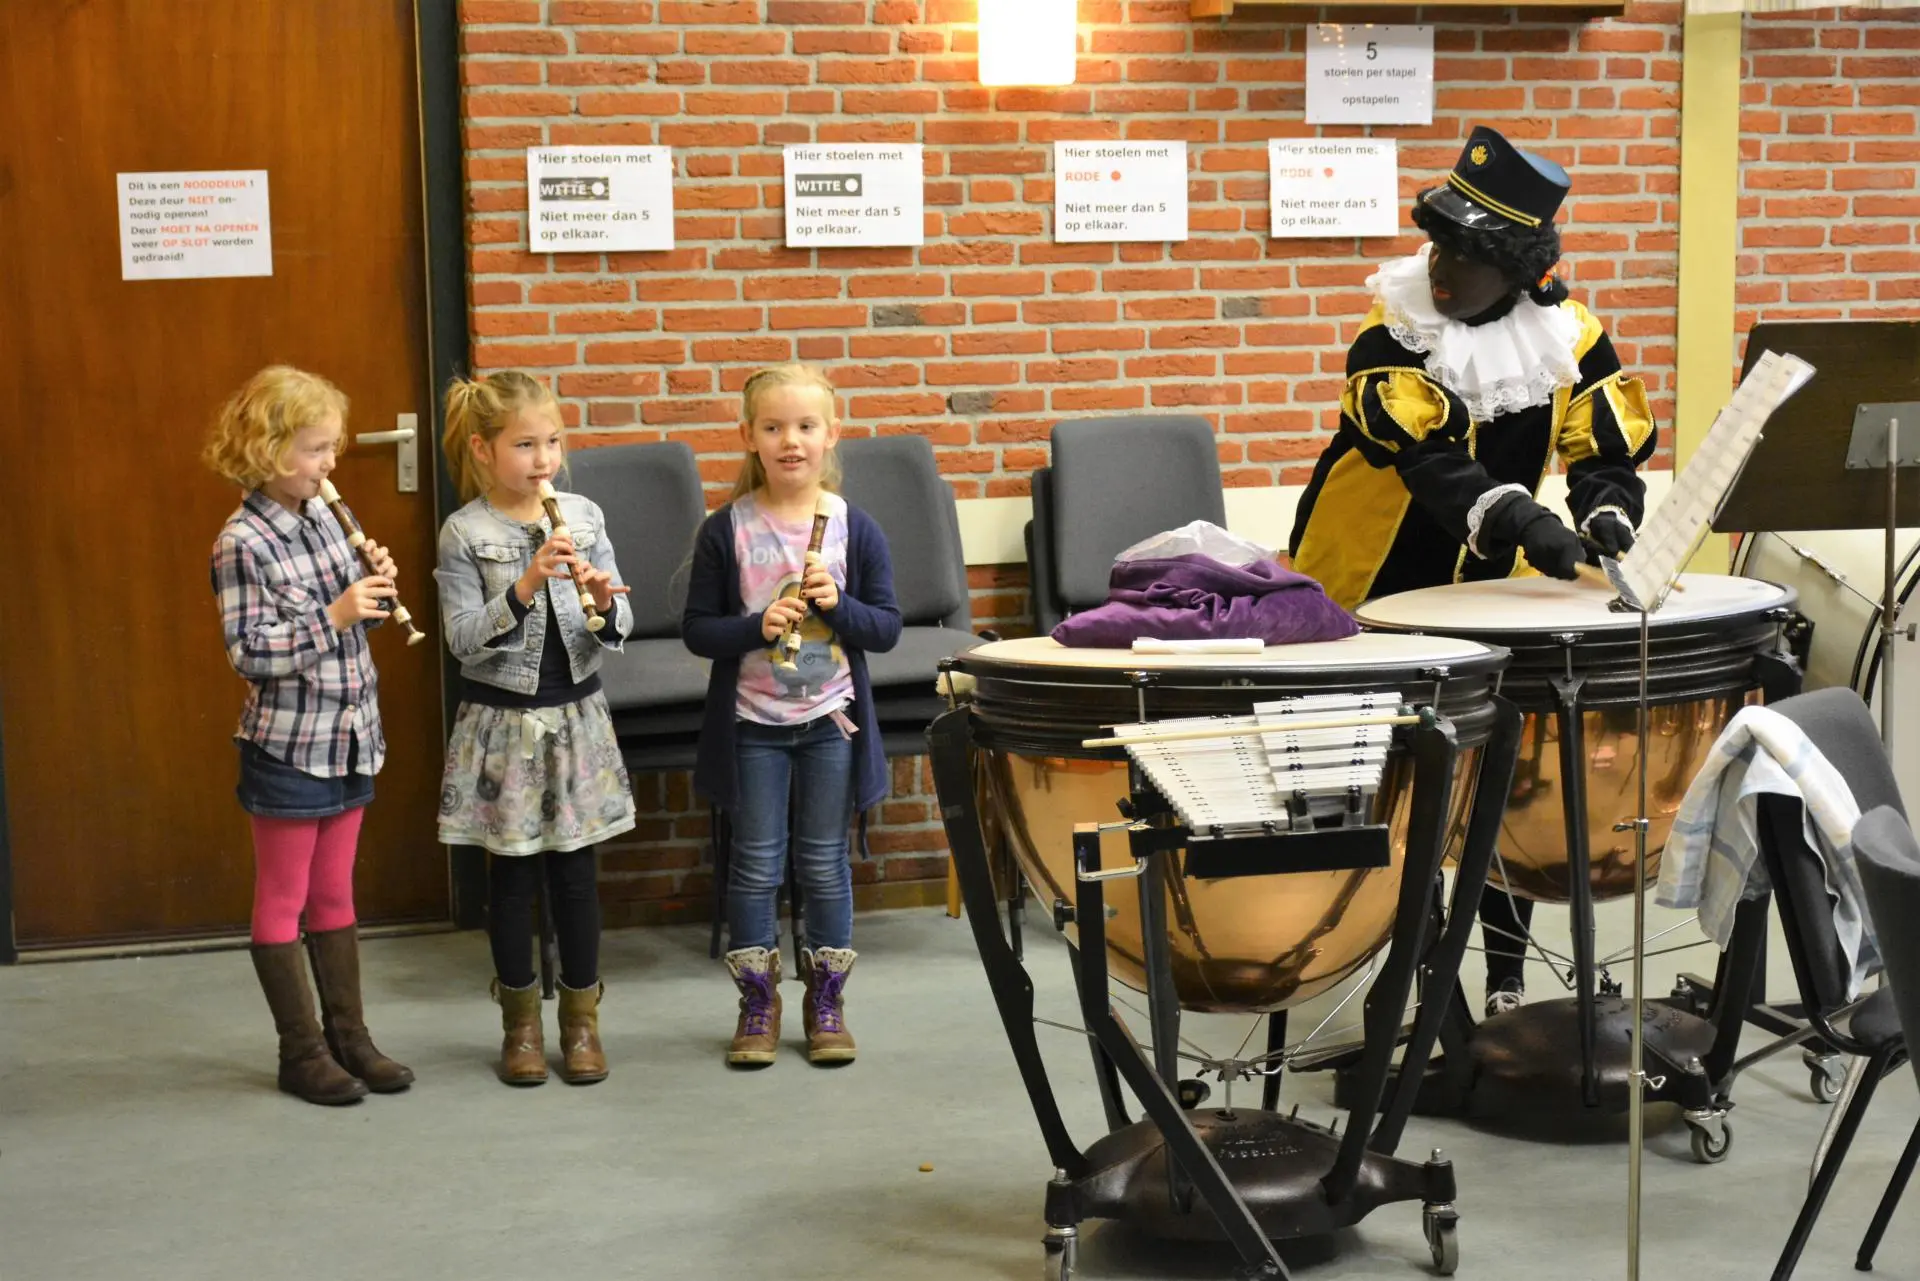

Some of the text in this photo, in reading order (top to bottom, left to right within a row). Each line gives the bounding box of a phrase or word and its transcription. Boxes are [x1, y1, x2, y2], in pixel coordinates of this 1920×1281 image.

[1366, 42, 1377, 60] 5
[1324, 68, 1416, 79] stoelen per stapel
[1342, 95, 1399, 106] opstapelen
[1065, 148, 1168, 157] Hier stoelen met
[1308, 145, 1351, 154] stoelen
[538, 154, 651, 163] Hier stoelen met
[795, 150, 902, 160] Hier stoelen met
[1065, 172, 1100, 181] RODE
[128, 182, 143, 190] Dit
[148, 182, 157, 190] is
[541, 183, 586, 195] WITTE
[796, 181, 840, 192] WITTE
[129, 197, 156, 206] Deze
[160, 197, 184, 205] deur
[188, 196, 214, 204] NIET
[1281, 199, 1377, 209] Niet meer dan 5
[796, 207, 900, 216] Niet meer dan 5
[1065, 203, 1166, 213] Niet meer dan 5
[130, 210, 208, 220] nodig openen!
[541, 211, 649, 221] Niet meer dan 5
[1065, 220, 1128, 231] op elkaar.
[1281, 216, 1341, 226] op elkaar.
[131, 226, 156, 235] Deur
[161, 225, 190, 233] MOET
[215, 224, 258, 232] OPENEN
[796, 224, 861, 236] op elkaar.
[541, 229, 608, 241] op elkaar.
[132, 238, 253, 248] weer OP SLOT worden
